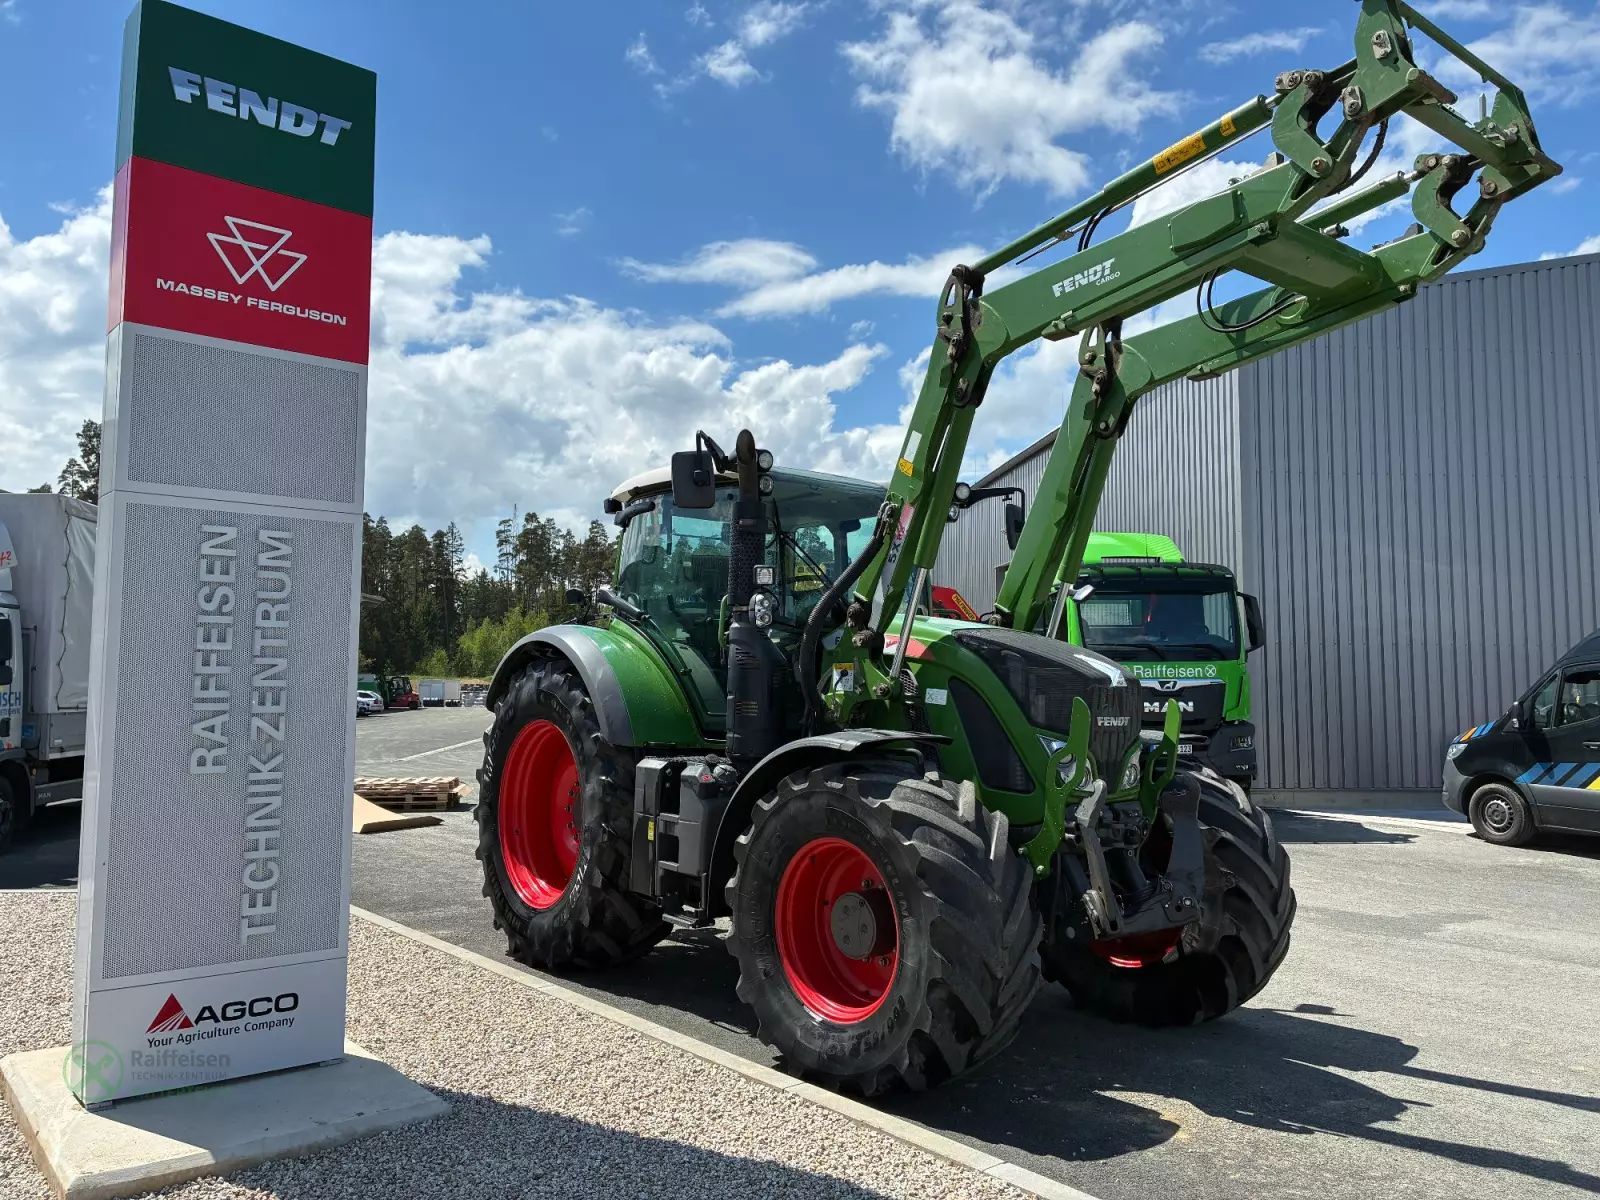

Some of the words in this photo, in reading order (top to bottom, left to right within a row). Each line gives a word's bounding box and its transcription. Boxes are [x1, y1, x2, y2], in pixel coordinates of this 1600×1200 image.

[168, 66, 352, 146] FENDT
[1052, 257, 1115, 298] FENDT
[1096, 271, 1121, 286] CARGO
[156, 278, 242, 304] MASSEY
[247, 297, 347, 326] FERGUSON
[190, 525, 238, 775] RAIFFEISEN
[1133, 664, 1203, 678] Raiffeisen
[240, 529, 293, 946] TECHNIK-ZENTRUM
[1097, 716, 1131, 727] FENDT
[194, 992, 299, 1026] AGCO
[147, 1036, 173, 1048] Your
[176, 1025, 240, 1045] Agriculture
[244, 1017, 295, 1031] Company
